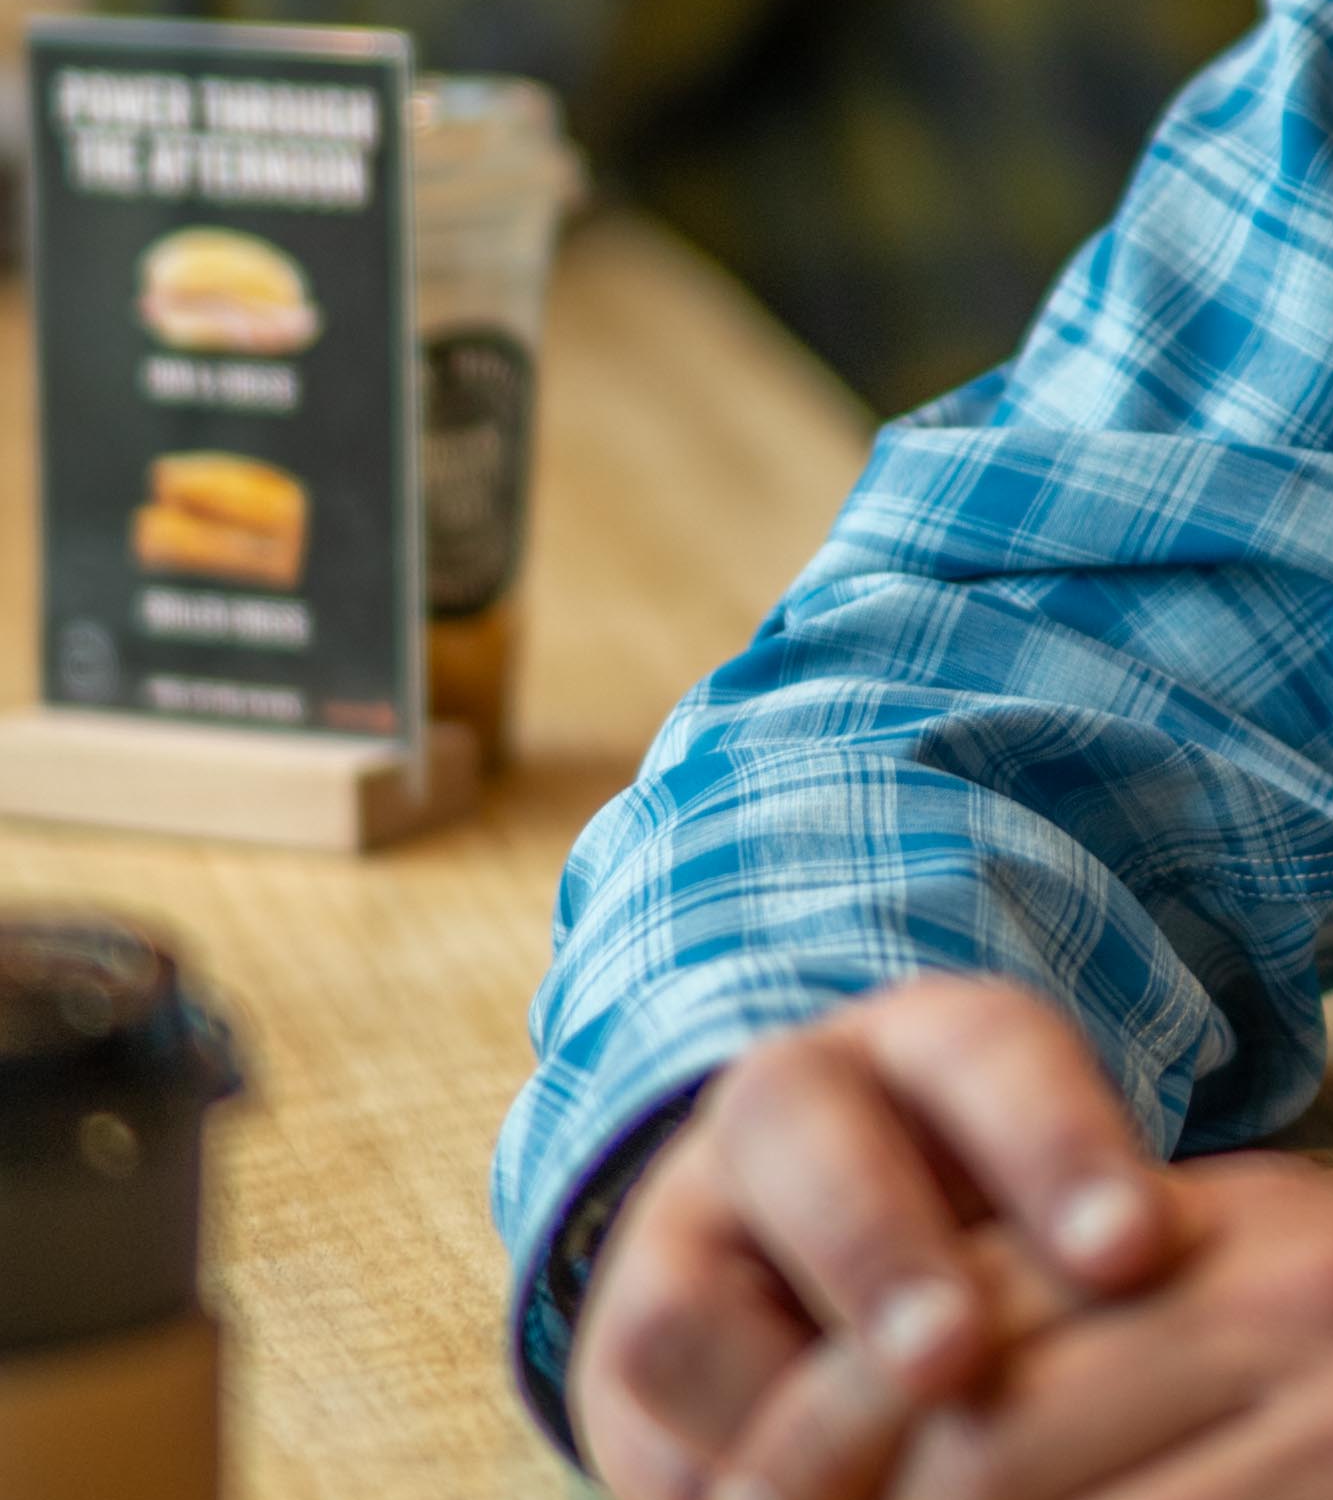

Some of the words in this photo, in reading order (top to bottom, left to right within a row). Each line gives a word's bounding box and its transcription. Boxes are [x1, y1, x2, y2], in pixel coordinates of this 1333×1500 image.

[59, 70, 191, 129] POWER
[202, 76, 379, 145] THROUGH
[73, 131, 139, 192] THE
[148, 136, 369, 207] AFTERNOON
